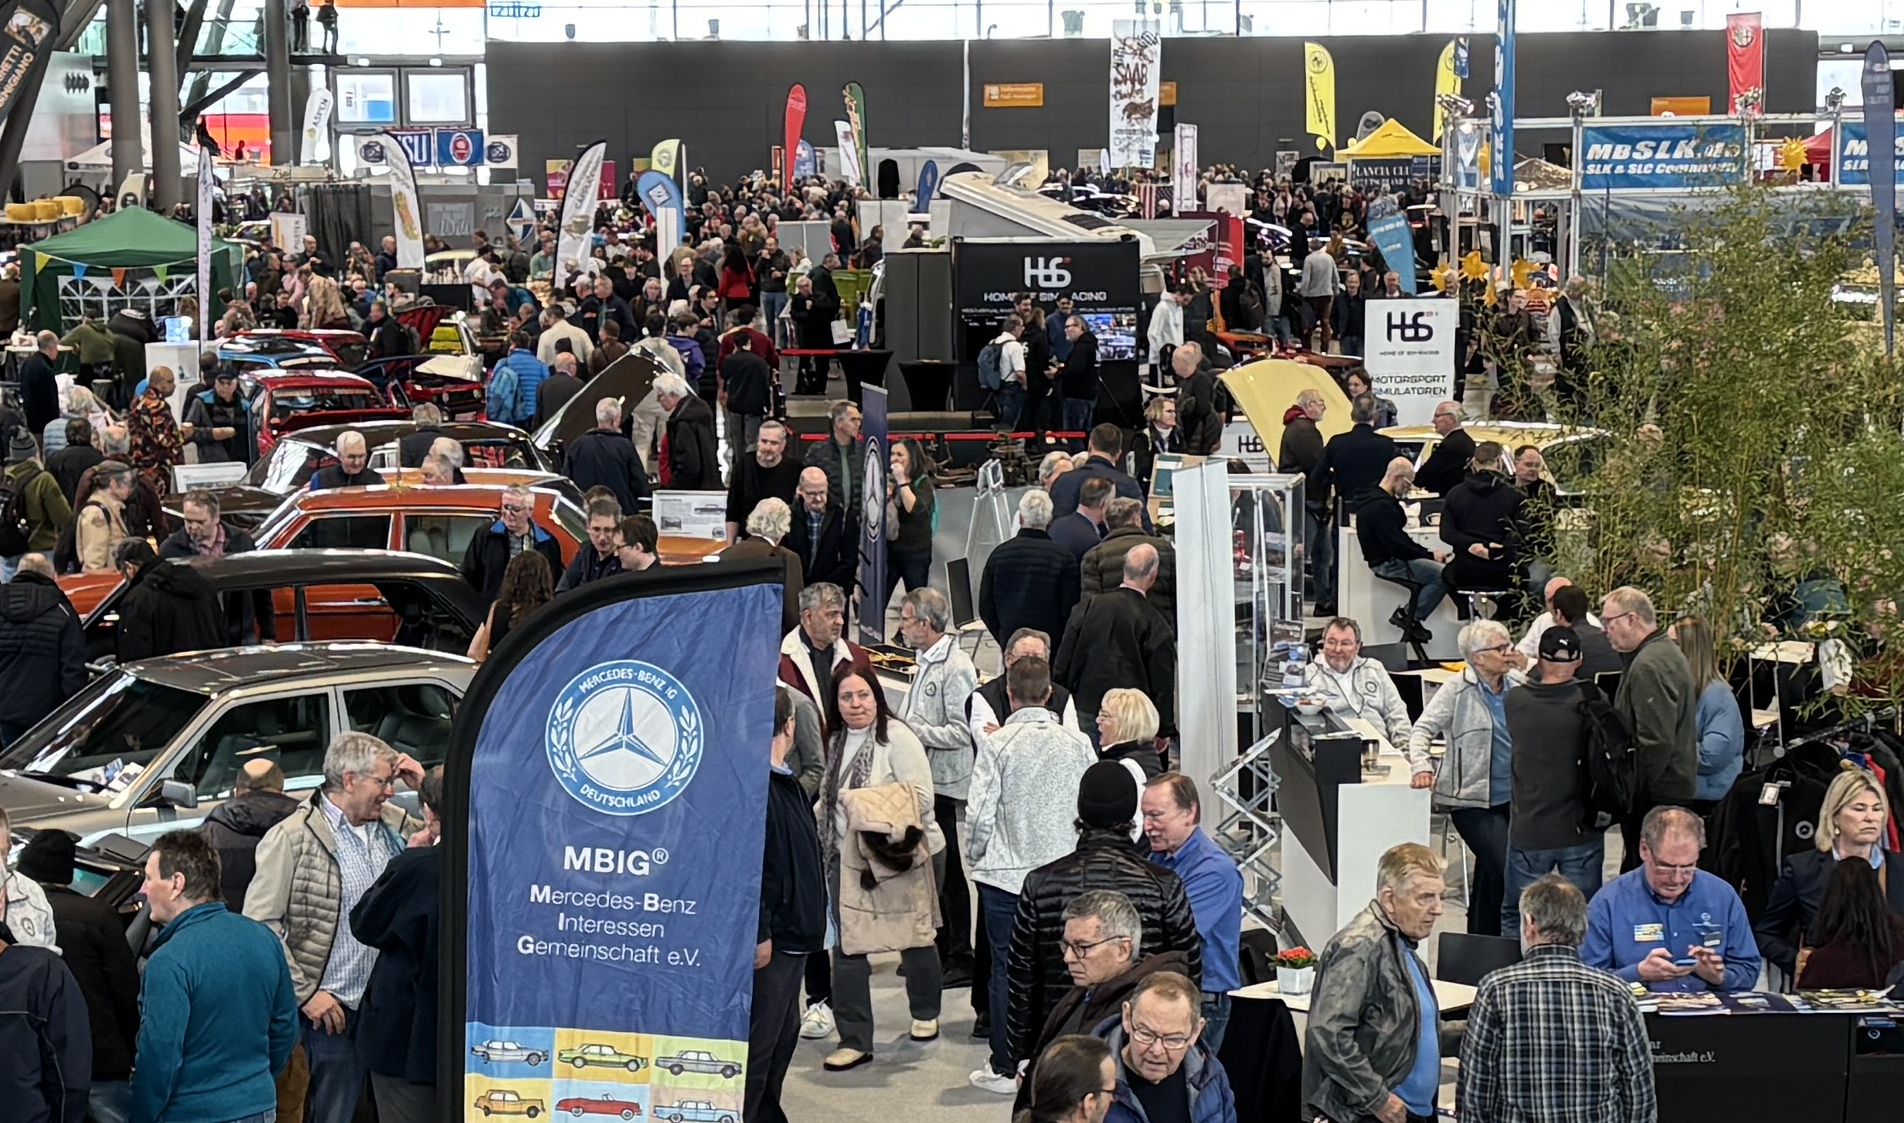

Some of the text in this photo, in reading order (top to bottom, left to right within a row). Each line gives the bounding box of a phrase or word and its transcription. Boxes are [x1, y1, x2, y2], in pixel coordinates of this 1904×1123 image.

[1586, 164, 1612, 175] SLK
[1627, 164, 1654, 174] SLC
[1372, 374, 1446, 384] MOTORSPORT
[579, 668, 667, 694] MERCEDES-BENZ
[580, 785, 661, 808] DEUTSCHLAND
[530, 884, 696, 915] Mercedes-Benz
[558, 912, 665, 938] Interessen
[517, 935, 701, 967] Gemeinschaft e.V.
